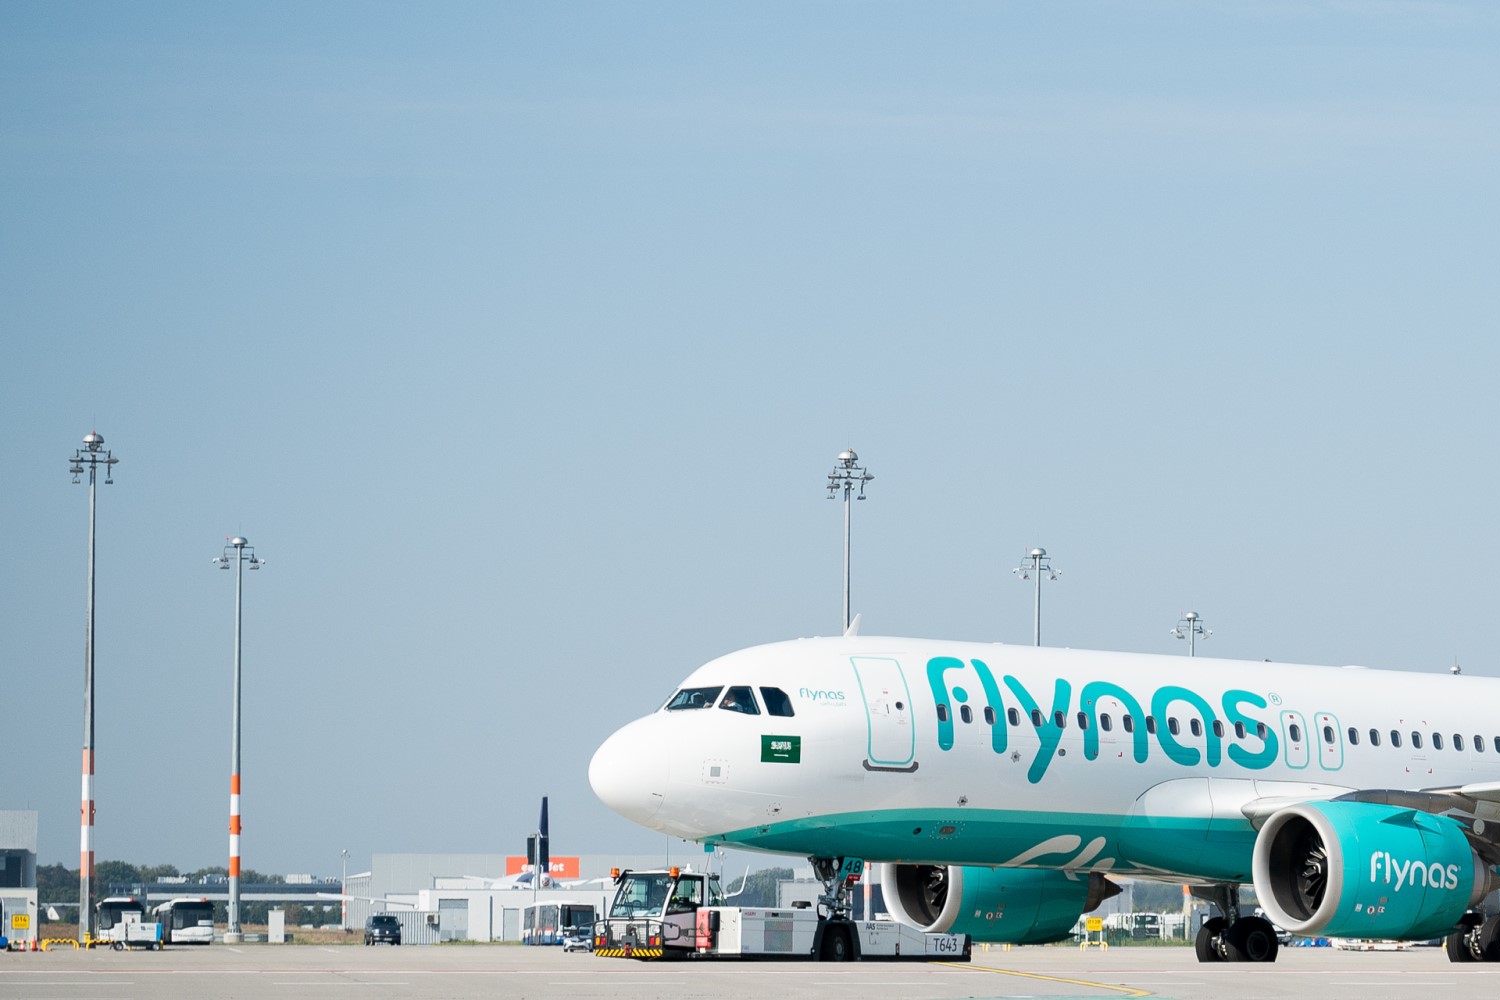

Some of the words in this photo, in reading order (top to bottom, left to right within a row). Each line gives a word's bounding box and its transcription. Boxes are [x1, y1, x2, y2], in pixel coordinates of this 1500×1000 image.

[799, 687, 846, 701] flynas
[926, 656, 1280, 784] flynas
[844, 859, 862, 873] 48
[1370, 850, 1459, 892] flynas
[932, 938, 958, 952] T643
